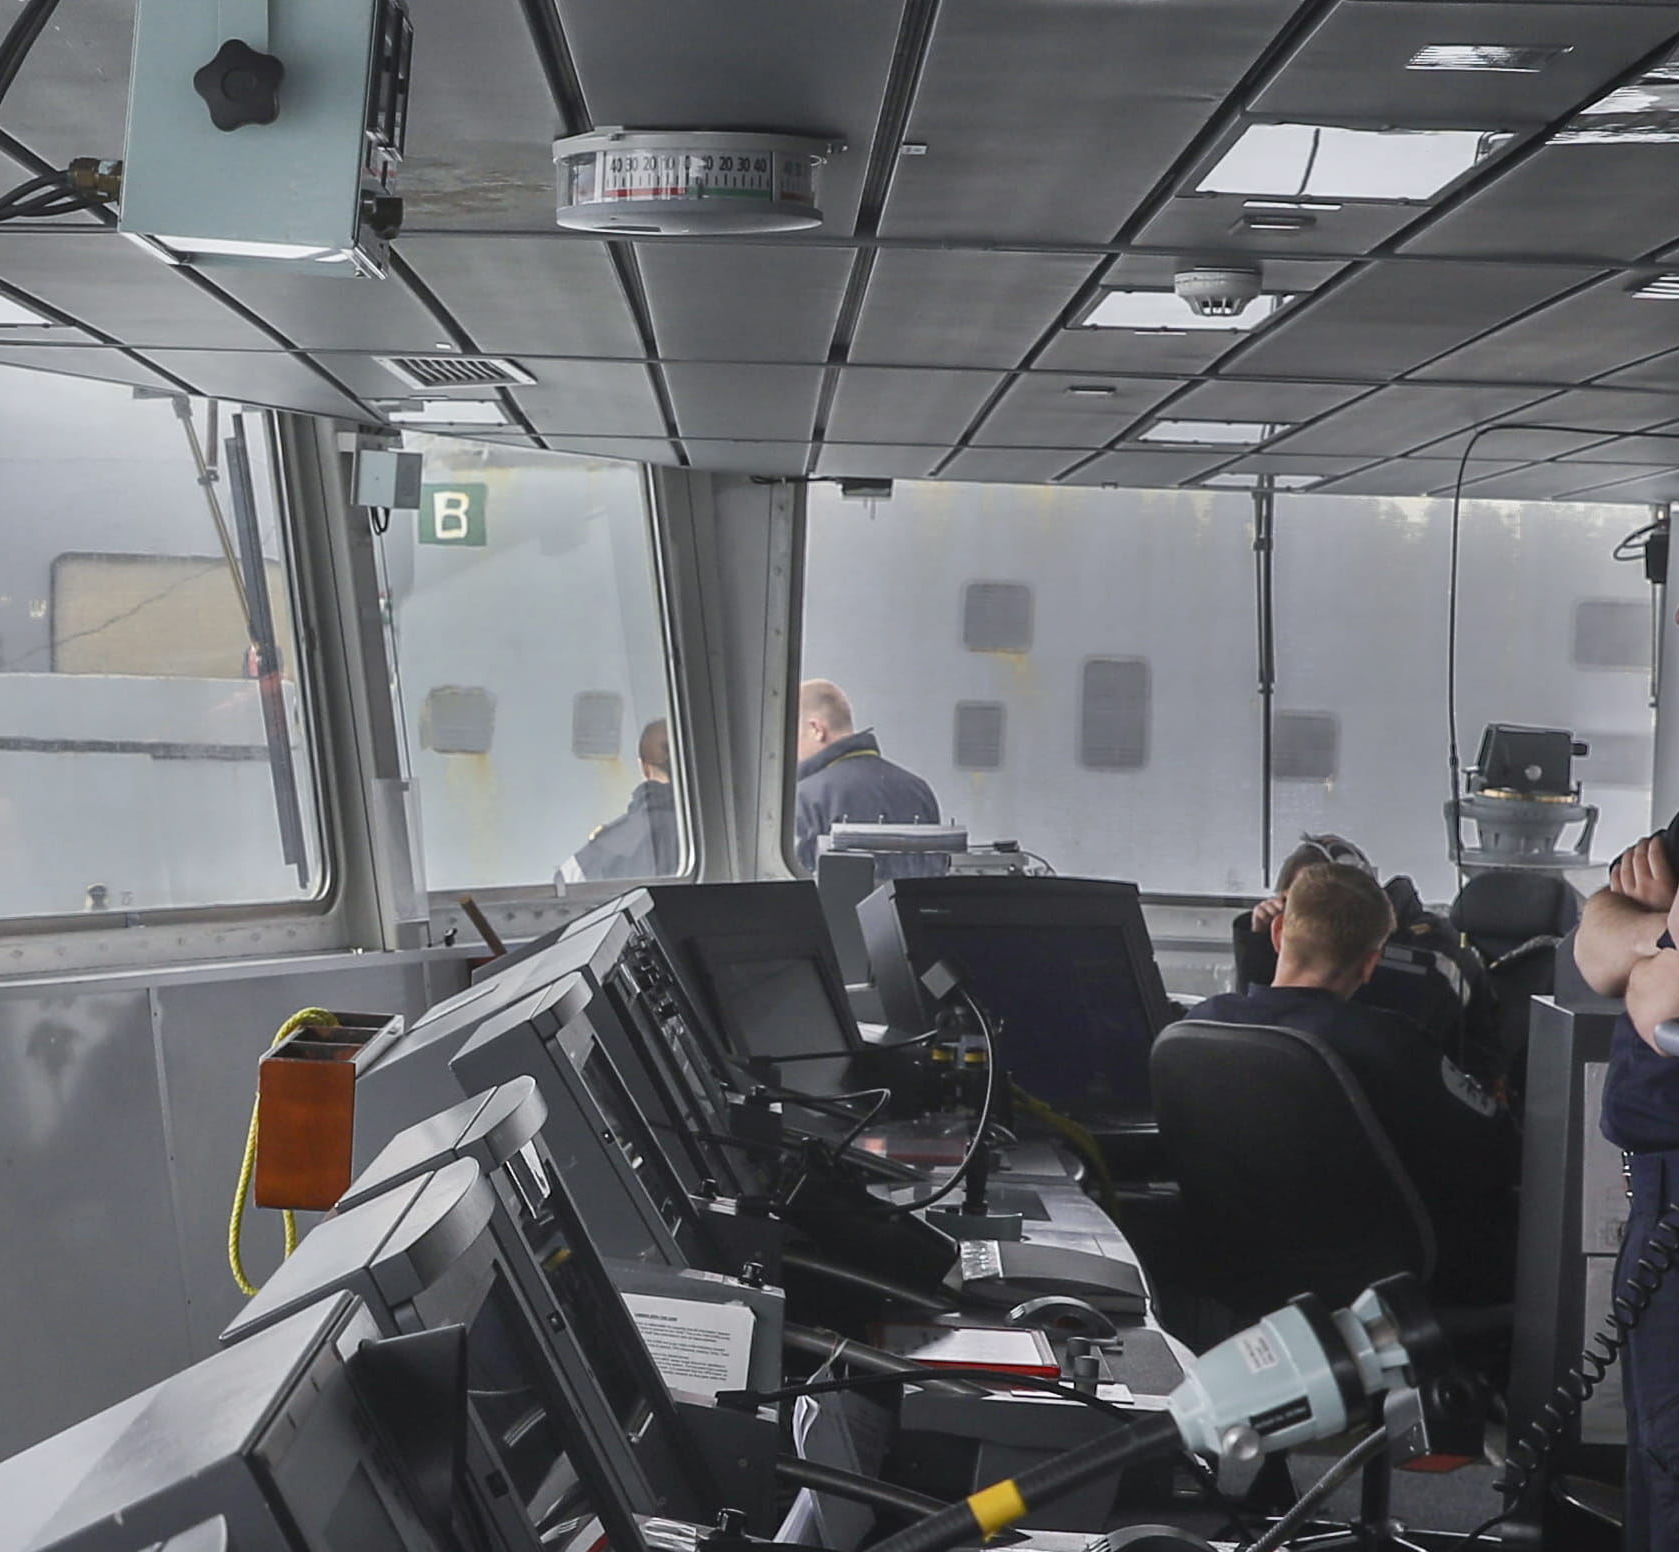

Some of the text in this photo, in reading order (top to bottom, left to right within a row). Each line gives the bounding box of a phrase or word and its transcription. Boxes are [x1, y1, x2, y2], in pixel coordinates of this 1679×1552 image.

[610, 158, 622, 173] 40
[625, 156, 638, 172] 30
[642, 156, 657, 171] 20
[719, 156, 733, 171] 20
[737, 156, 750, 172] 30
[754, 156, 767, 173] 40
[433, 490, 471, 541] B
